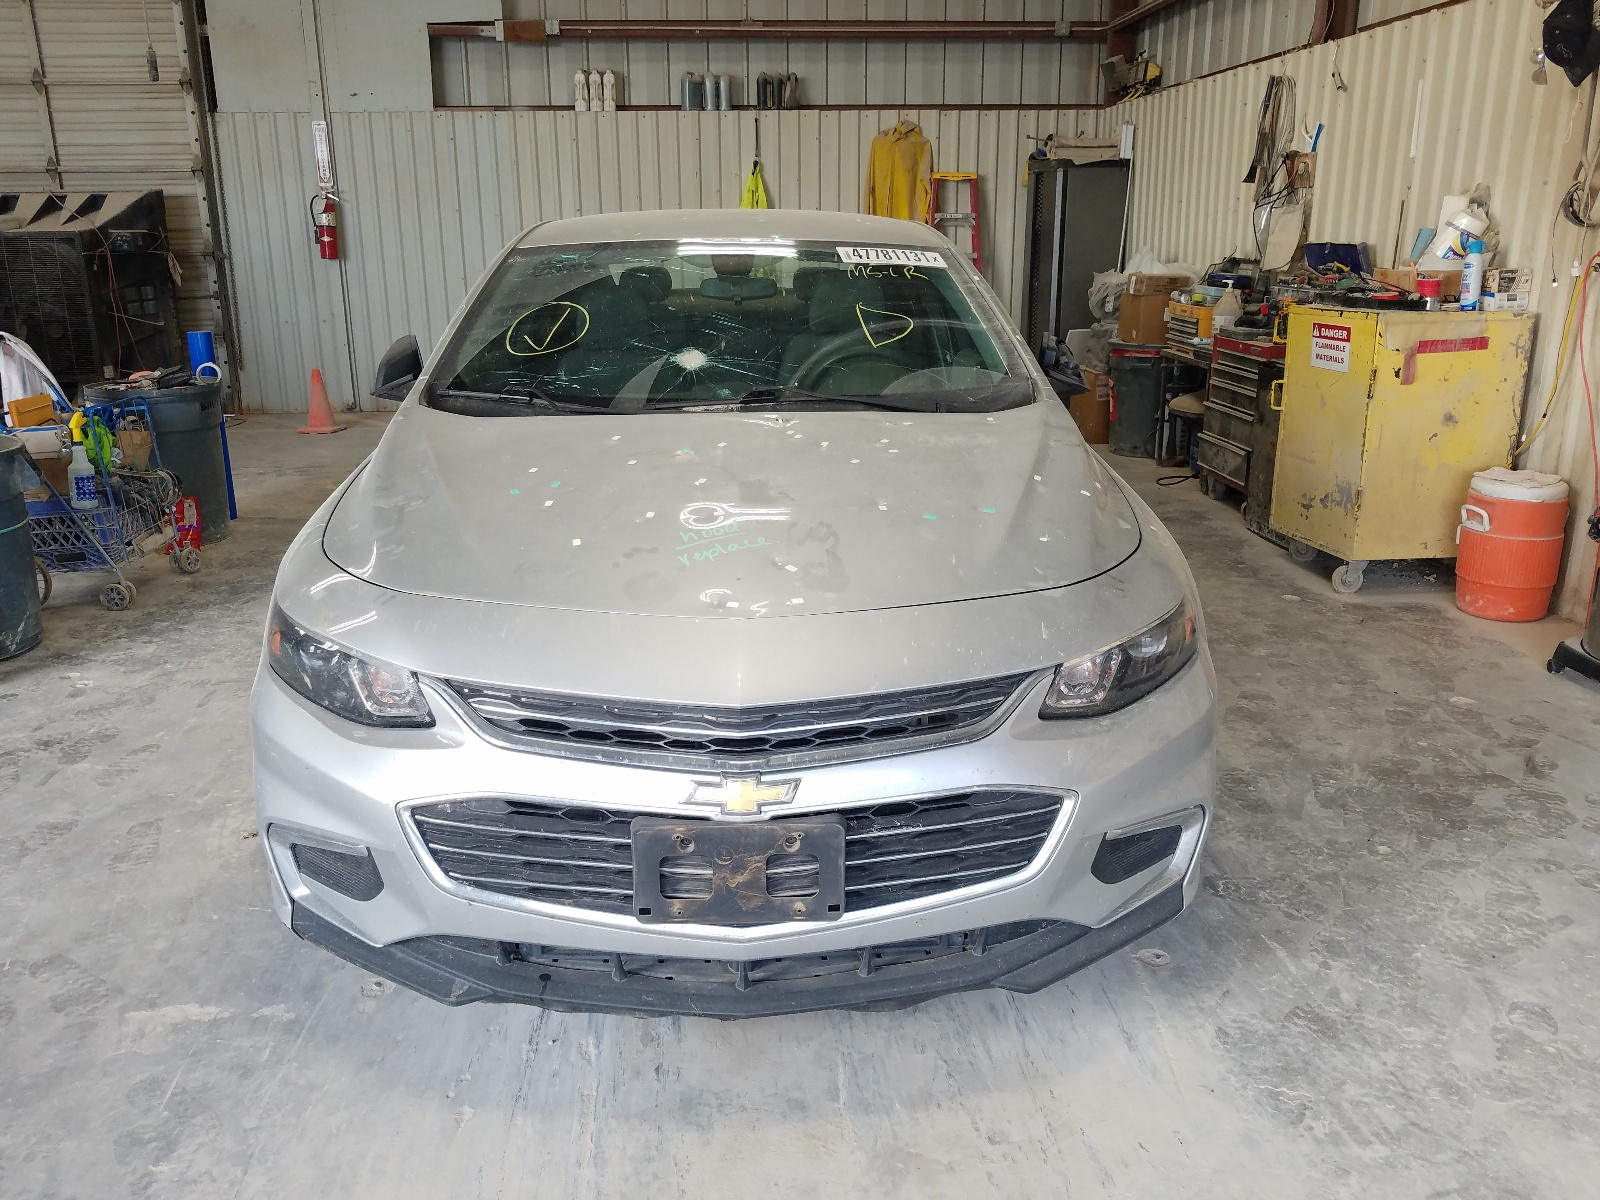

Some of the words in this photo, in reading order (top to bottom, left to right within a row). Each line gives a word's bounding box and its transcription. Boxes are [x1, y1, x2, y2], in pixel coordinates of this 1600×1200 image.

[852, 248, 931, 263] 47781131
[1320, 327, 1348, 340] DANGER
[1315, 341, 1346, 353] FLAMMABLE
[1315, 353, 1345, 365] MATERIALS
[677, 537, 773, 566] replace
